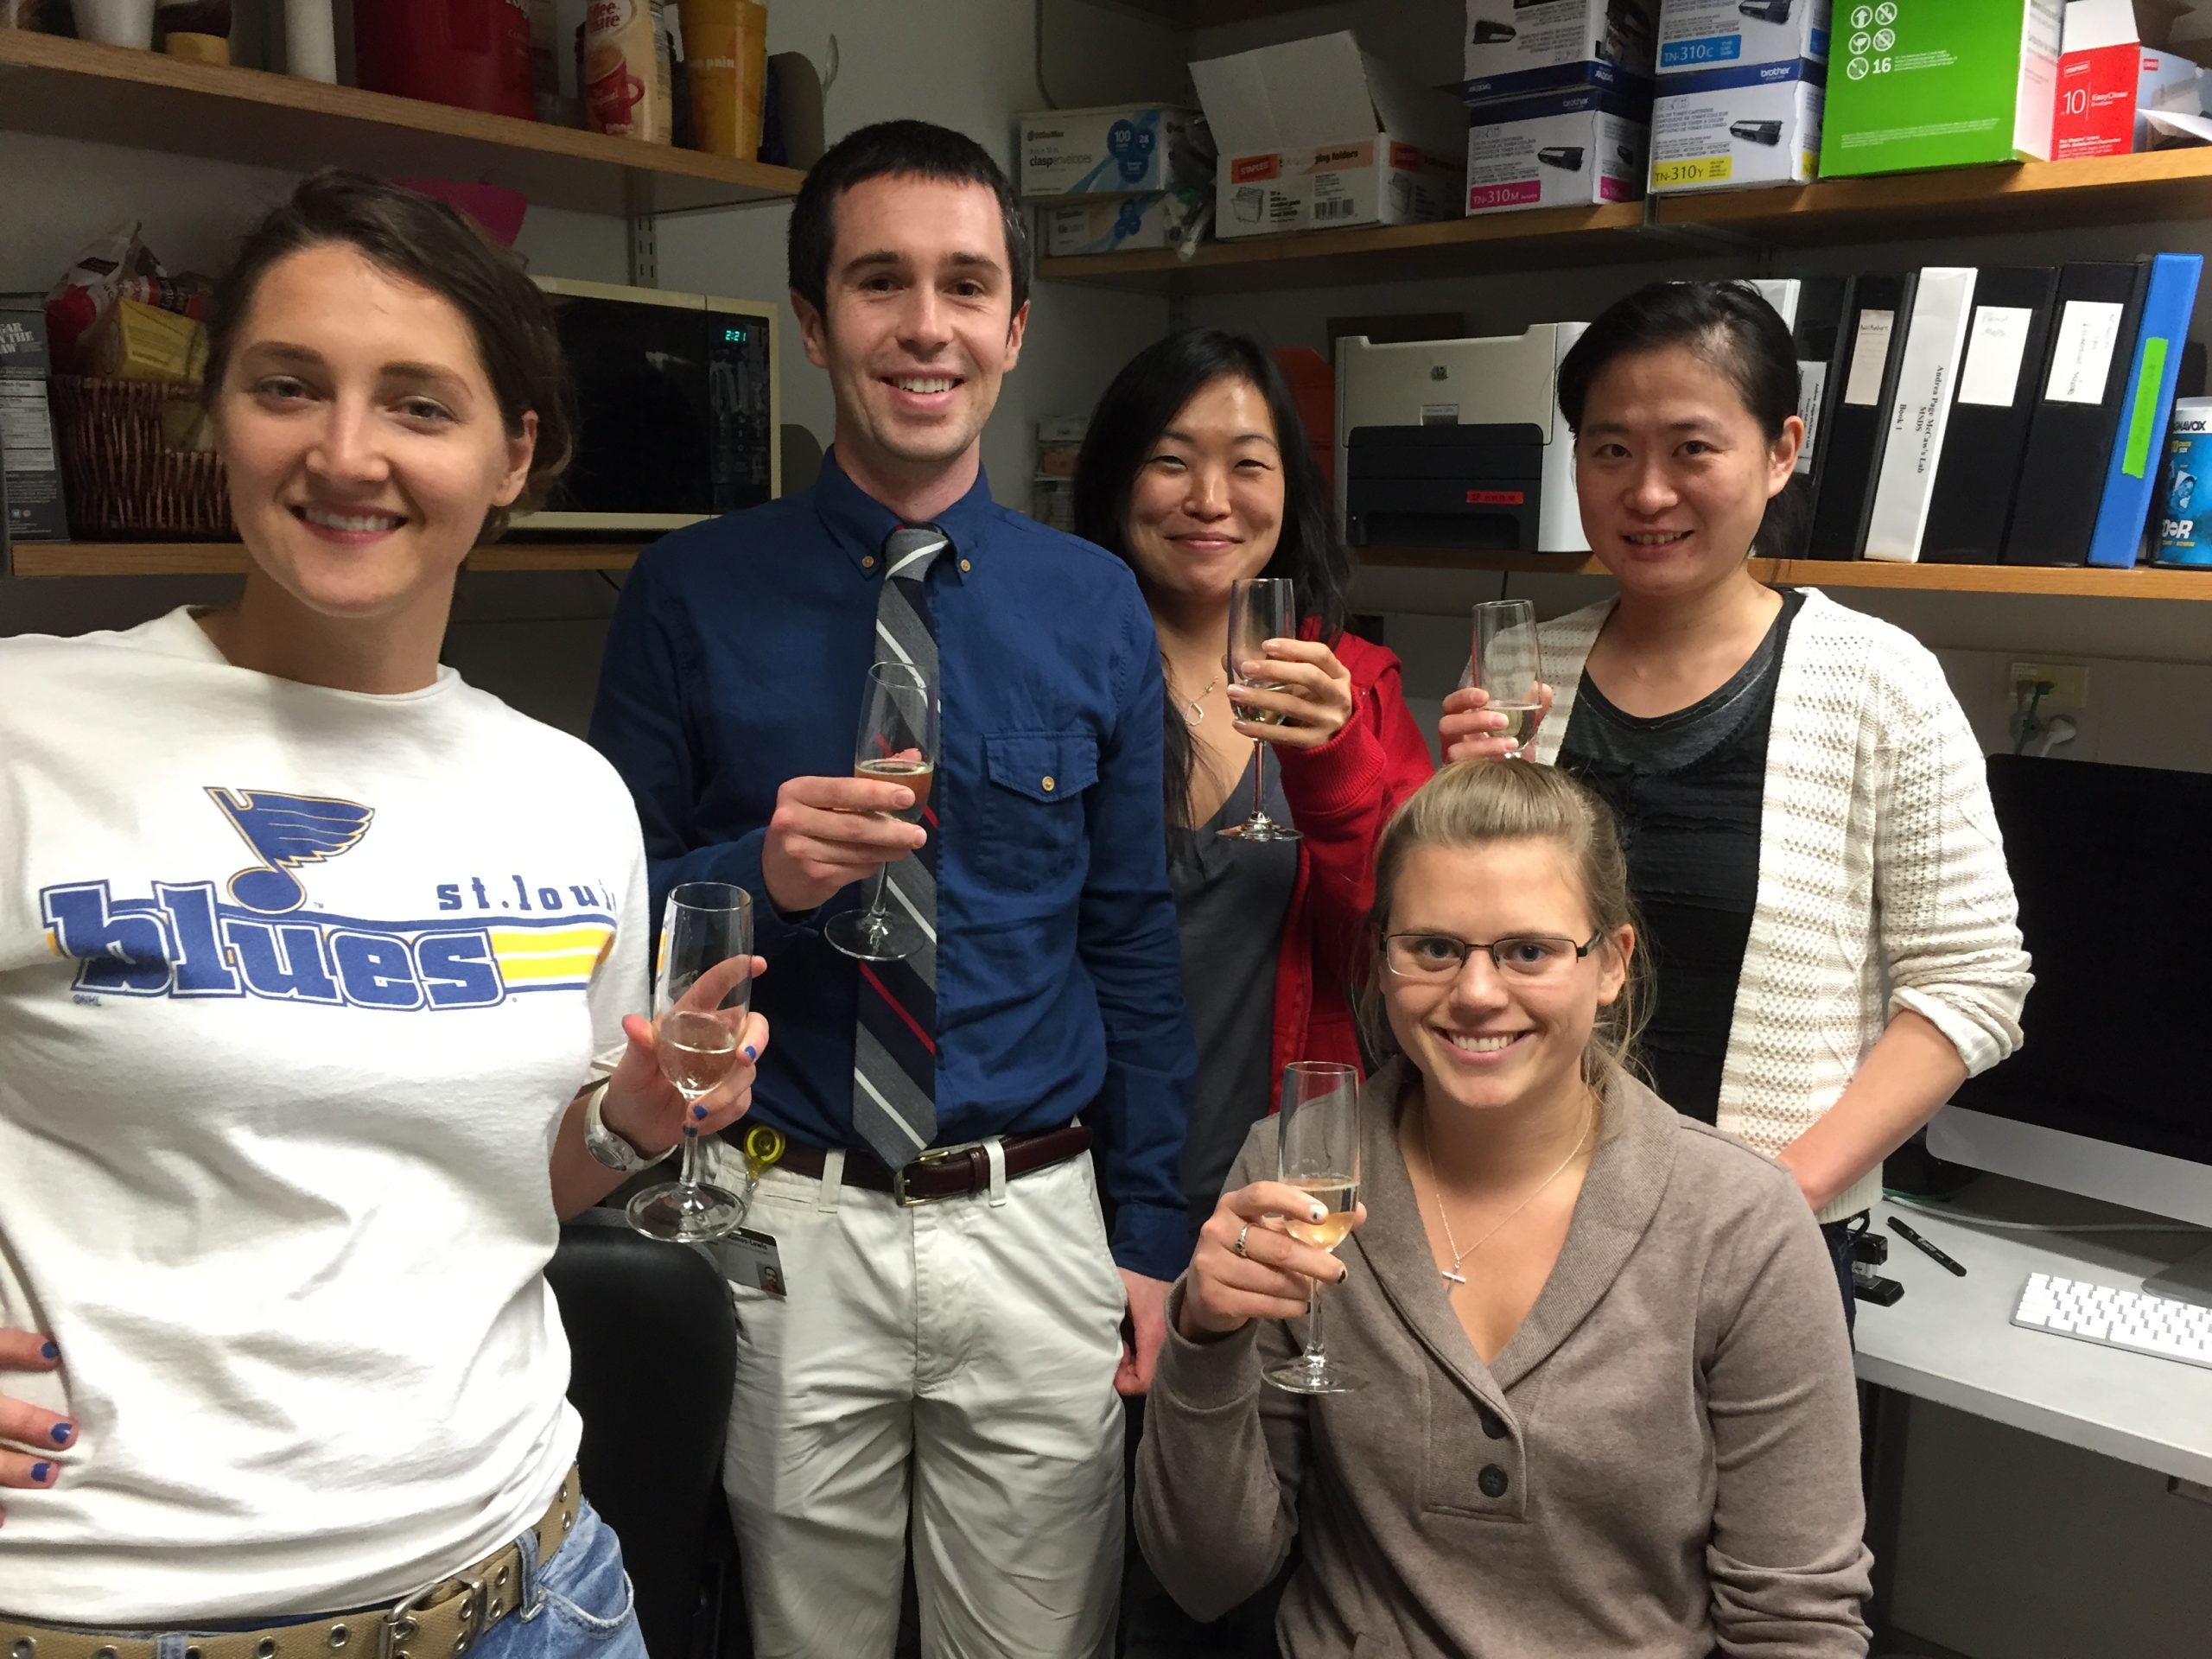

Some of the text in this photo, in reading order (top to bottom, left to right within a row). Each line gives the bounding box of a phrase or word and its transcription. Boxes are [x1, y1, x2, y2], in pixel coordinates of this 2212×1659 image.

[1664, 44, 1714, 63] TN-310C
[1761, 66, 1791, 78] brother
[1872, 57, 1892, 74] 16
[2063, 89, 2086, 114] 10
[1115, 130, 1131, 143] 100
[1656, 164, 1704, 182] TN-310Y
[1473, 188, 1519, 206] TN-310M
[725, 330, 747, 341] 2:21
[1933, 365, 1944, 395] Andrea
[1897, 404, 1907, 423] Book
[1928, 397, 1938, 416] Page
[1917, 457, 1927, 474] Lab
[40, 879, 507, 1011] blues
